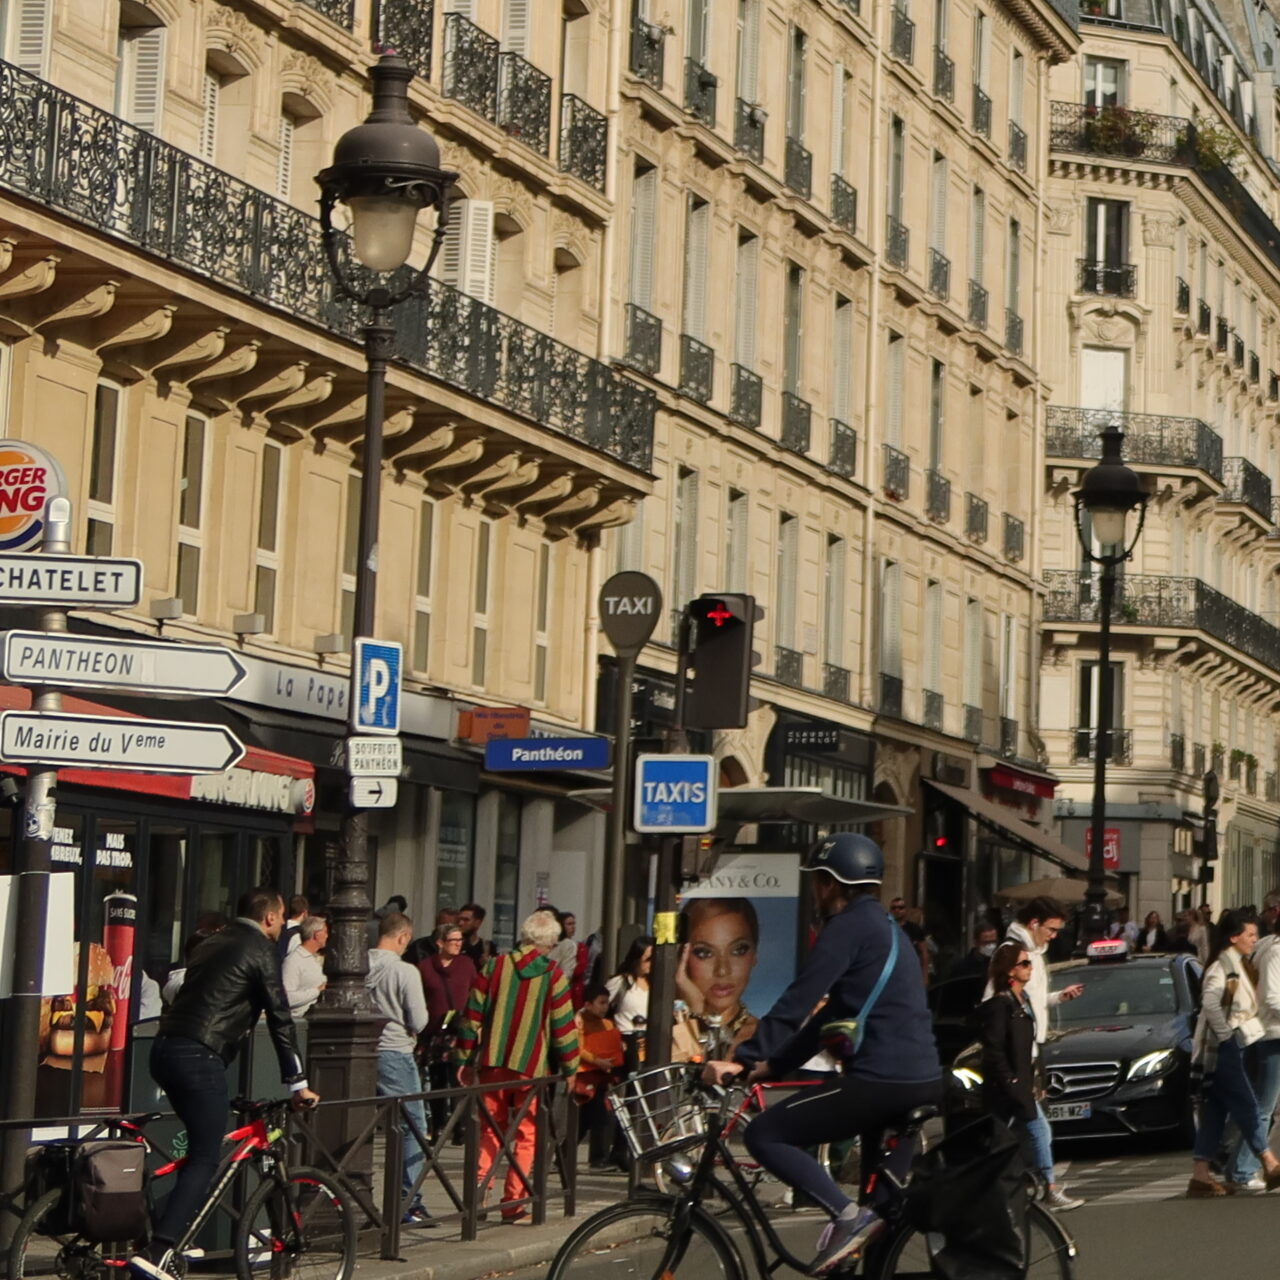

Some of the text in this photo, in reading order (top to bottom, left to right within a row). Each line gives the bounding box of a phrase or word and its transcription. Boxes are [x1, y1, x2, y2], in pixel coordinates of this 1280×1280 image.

[605, 597, 653, 615] TAXI
[20, 646, 134, 676] PANTHEON
[277, 670, 294, 698] La
[369, 658, 391, 714] P
[14, 725, 80, 752] Mairie
[89, 732, 112, 754] du
[355, 743, 397, 755] SOUFFLOT
[511, 746, 584, 762] Panthéon
[354, 755, 399, 770] PANTHÉON
[644, 781, 706, 804] TAXIS
[105, 833, 125, 849] MAIS
[96, 849, 111, 865] PAS
[738, 875, 751, 889] &
